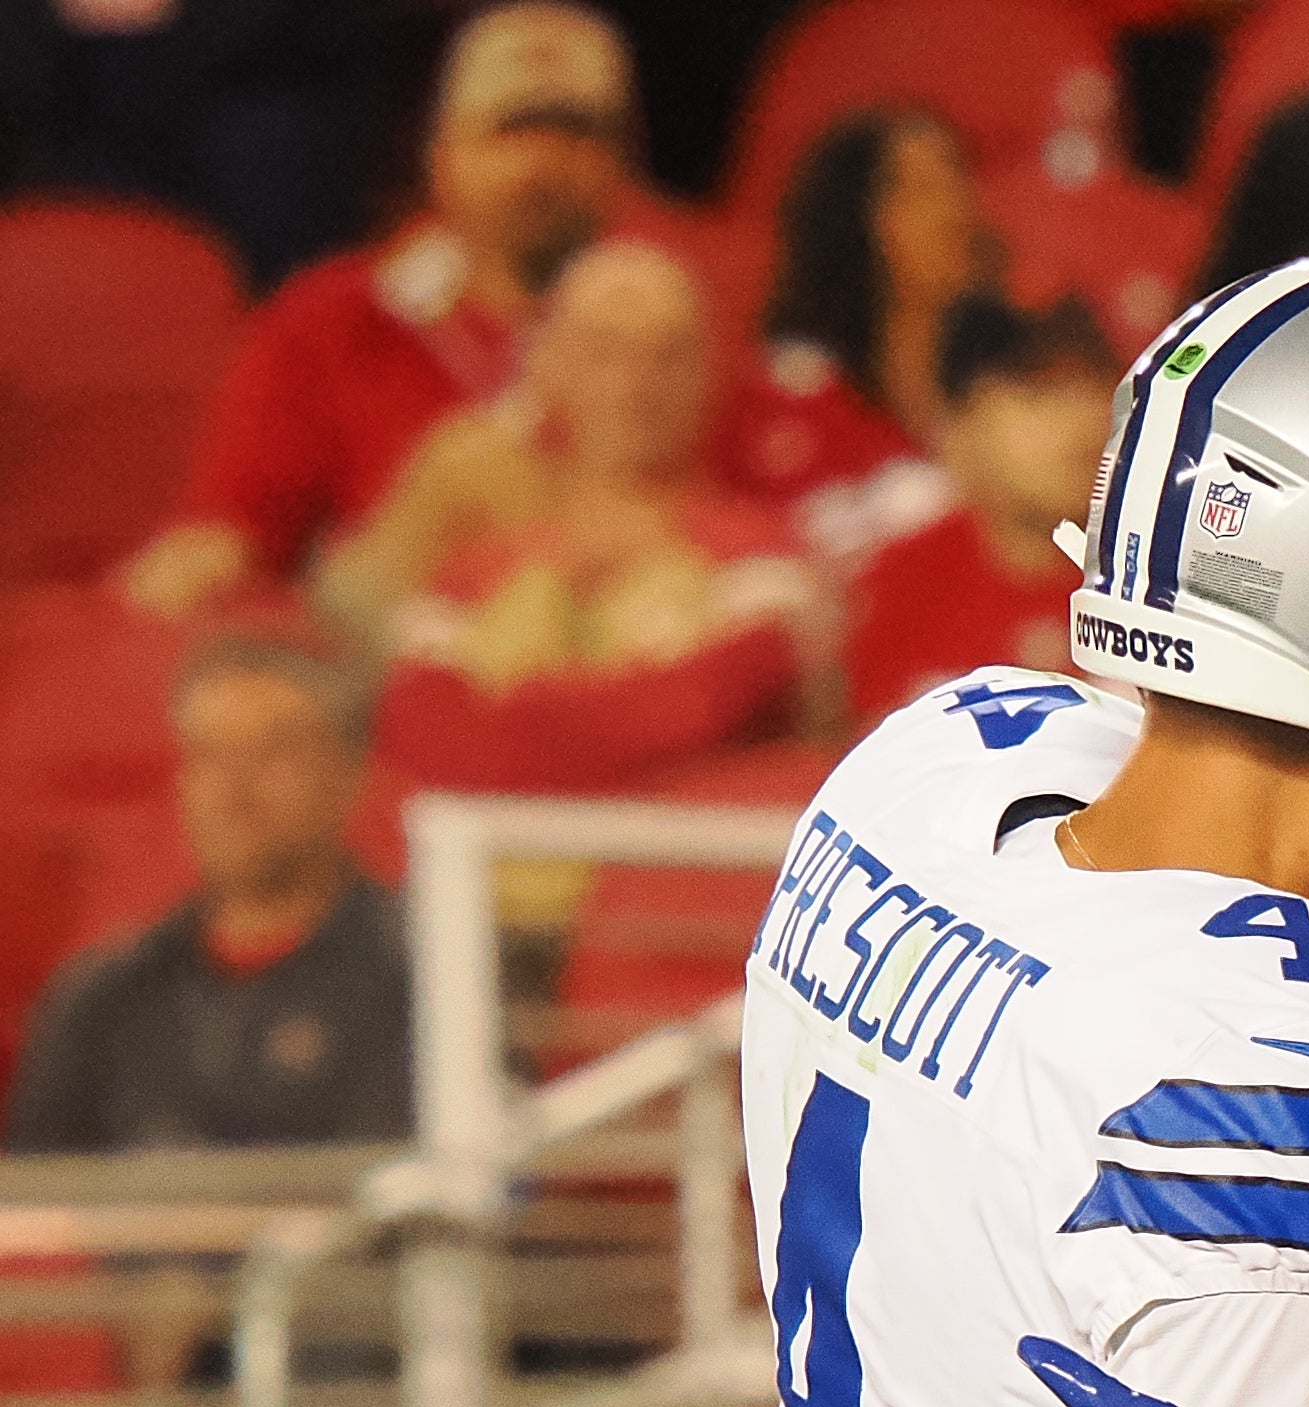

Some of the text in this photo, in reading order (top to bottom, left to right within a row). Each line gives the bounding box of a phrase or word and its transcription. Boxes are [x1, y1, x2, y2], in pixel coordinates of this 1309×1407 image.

[1203, 502, 1239, 534] NFL
[1076, 611, 1195, 674] COWBOYS
[752, 809, 1053, 1100] PRESCOTT
